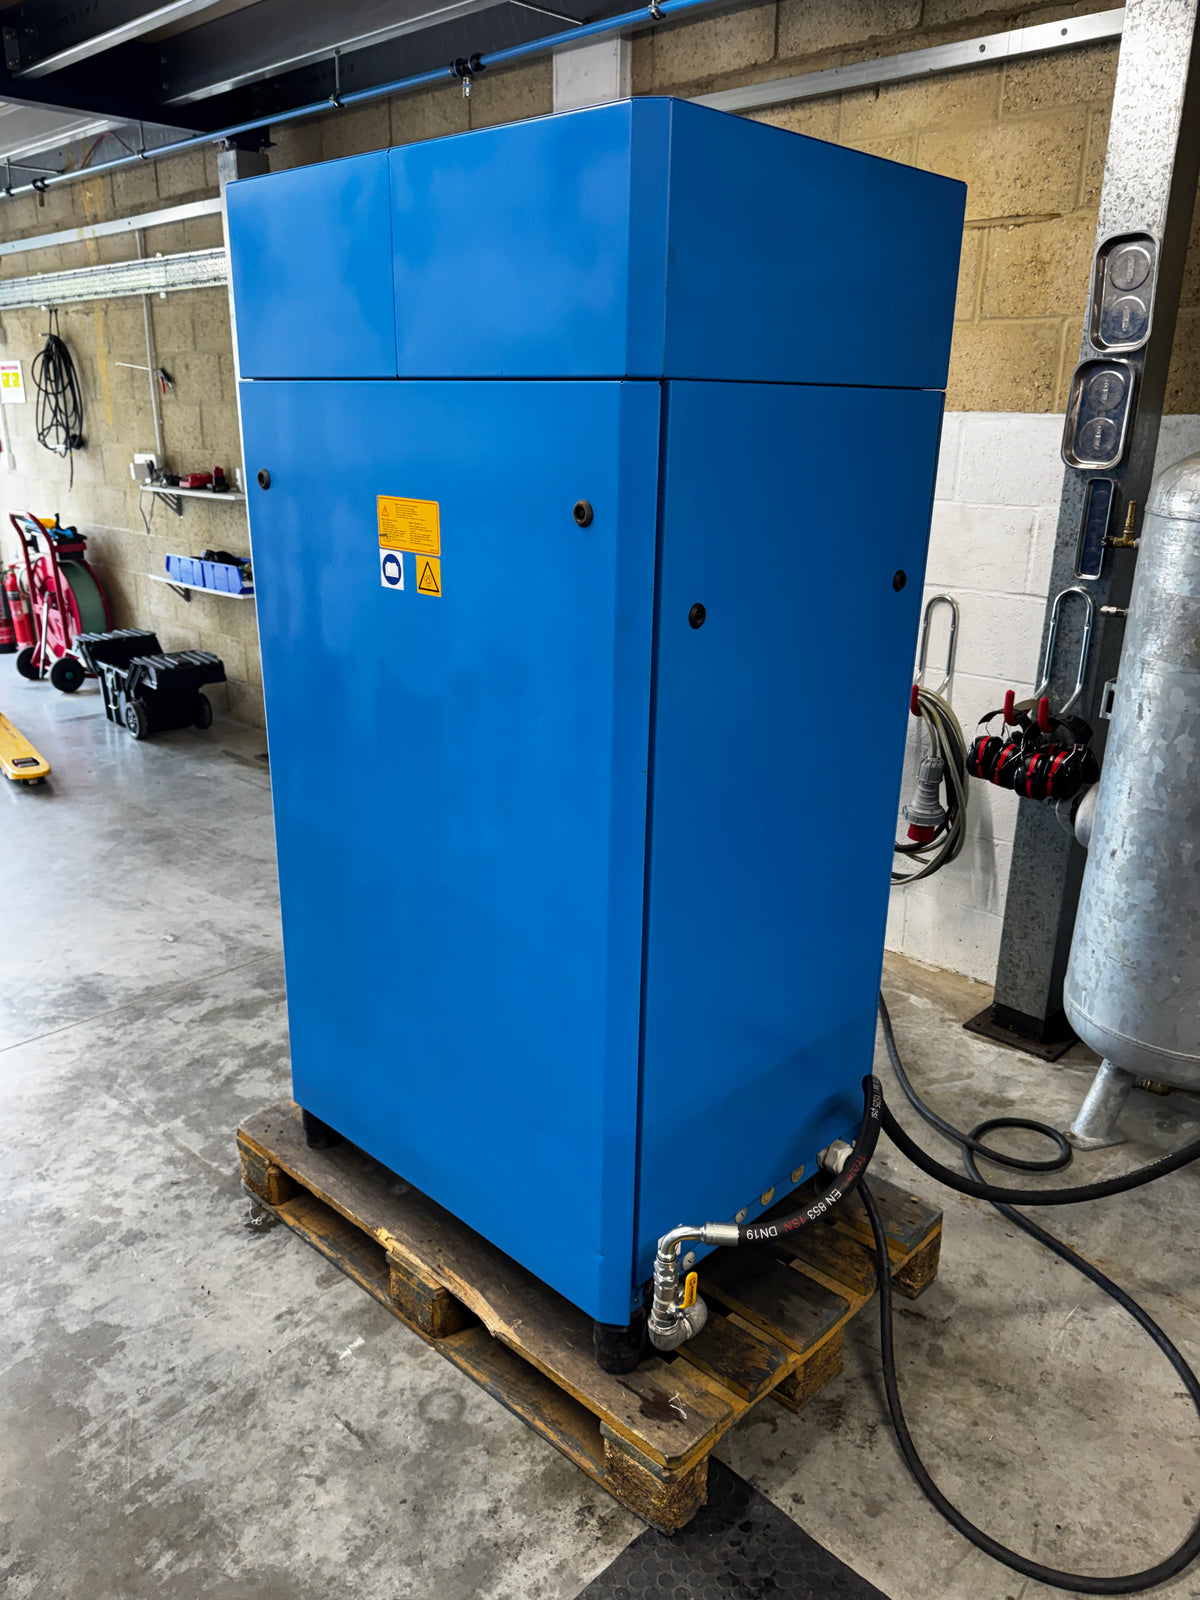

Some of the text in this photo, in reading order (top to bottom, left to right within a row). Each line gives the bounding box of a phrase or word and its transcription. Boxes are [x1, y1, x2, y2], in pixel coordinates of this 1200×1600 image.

[826, 1188, 842, 1206] EN
[807, 1202, 827, 1220] 853
[746, 1225, 778, 1240] DN19
[783, 1216, 806, 1232] 1SN
